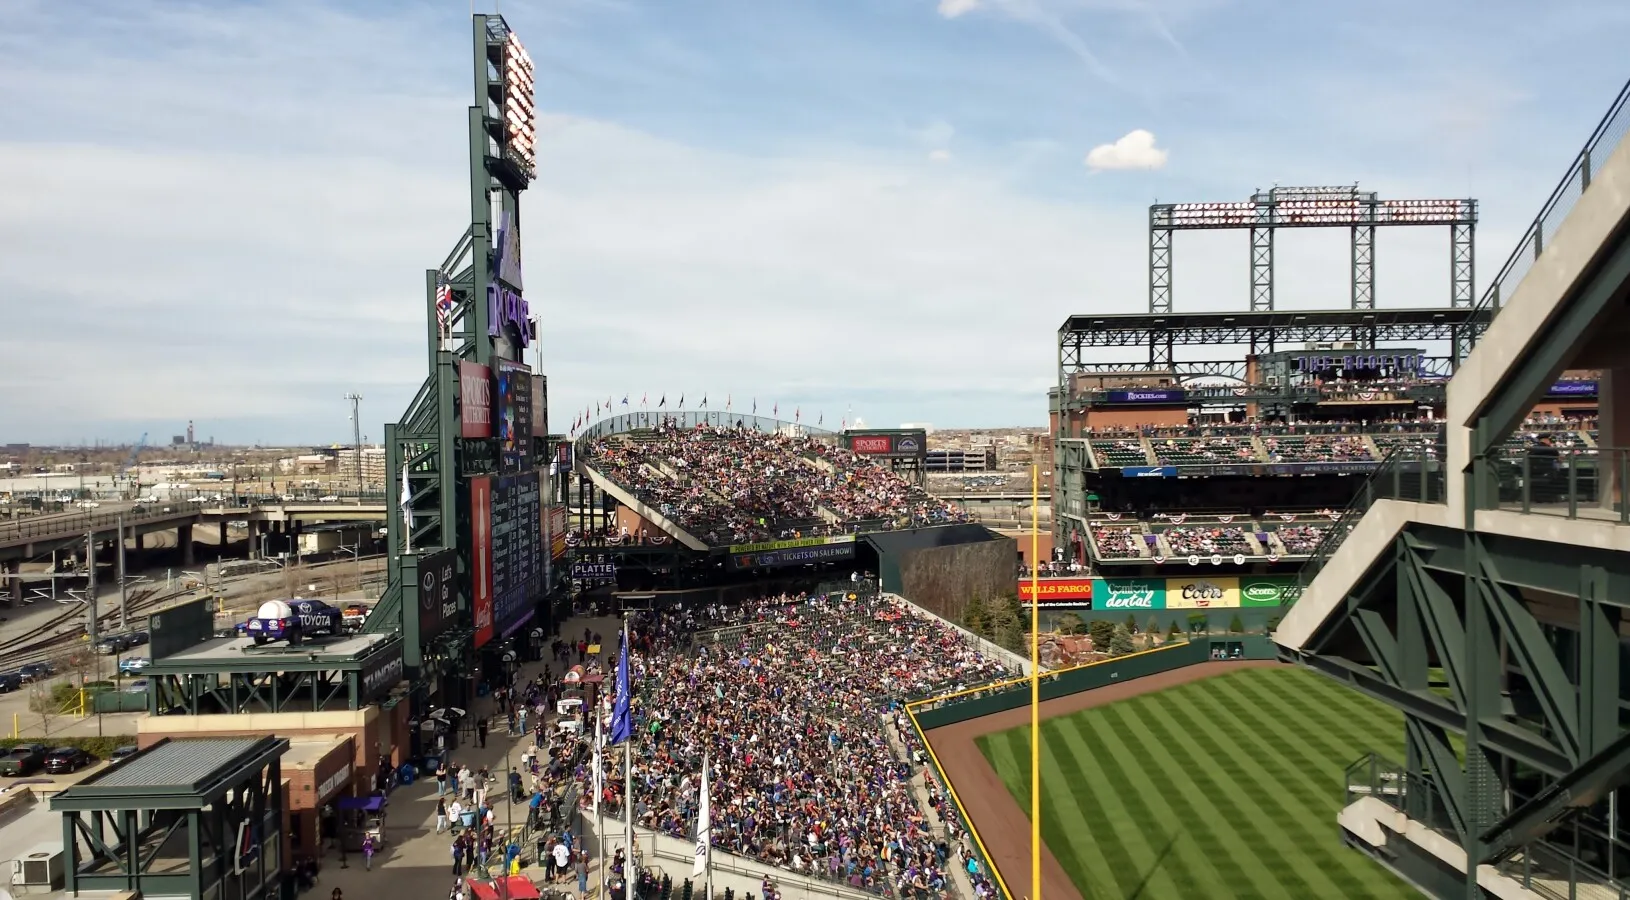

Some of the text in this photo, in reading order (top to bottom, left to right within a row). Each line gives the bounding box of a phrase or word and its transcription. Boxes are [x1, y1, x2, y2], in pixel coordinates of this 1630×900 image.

[1298, 355, 1426, 372] THE ROOFTOP
[461, 375, 490, 407] SPORTS
[462, 405, 491, 425] AUTHORITY
[855, 439, 887, 447] SPORTS
[783, 547, 852, 561] TICKETS ON SALE NOW!
[441, 564, 452, 582] Let's
[575, 564, 612, 573] PLATTE
[441, 584, 449, 600] Go
[1057, 584, 1091, 593] FARGO
[1107, 580, 1149, 594] Comfort
[1181, 584, 1223, 599] Coors
[1105, 590, 1155, 608] dental
[442, 601, 457, 618] Places
[298, 614, 331, 627] TOYOTA
